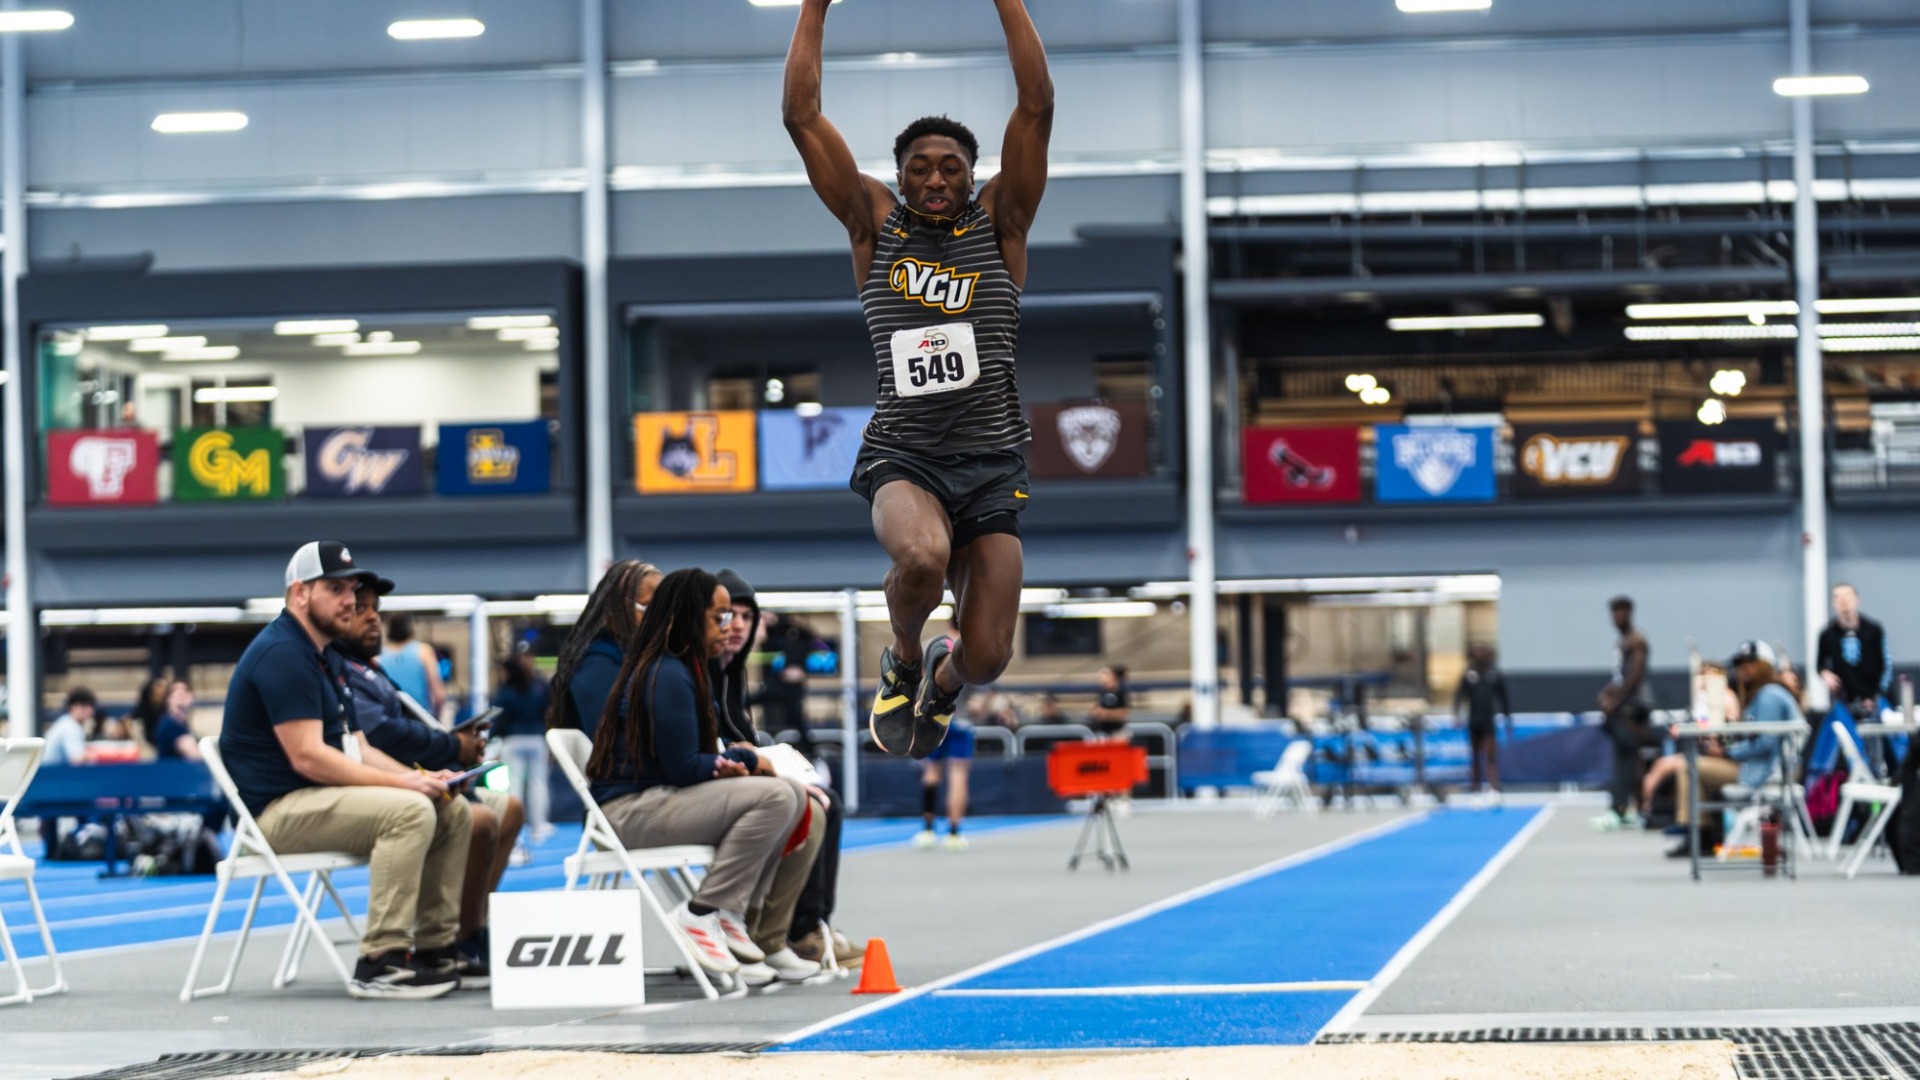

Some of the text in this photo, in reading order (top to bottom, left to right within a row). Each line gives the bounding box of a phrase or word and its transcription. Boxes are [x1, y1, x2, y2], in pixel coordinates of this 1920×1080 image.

[891, 259, 977, 313] VCU
[908, 352, 965, 388] 549
[187, 430, 268, 496] GM
[1523, 434, 1630, 484] VCU
[506, 933, 626, 968] GILL
